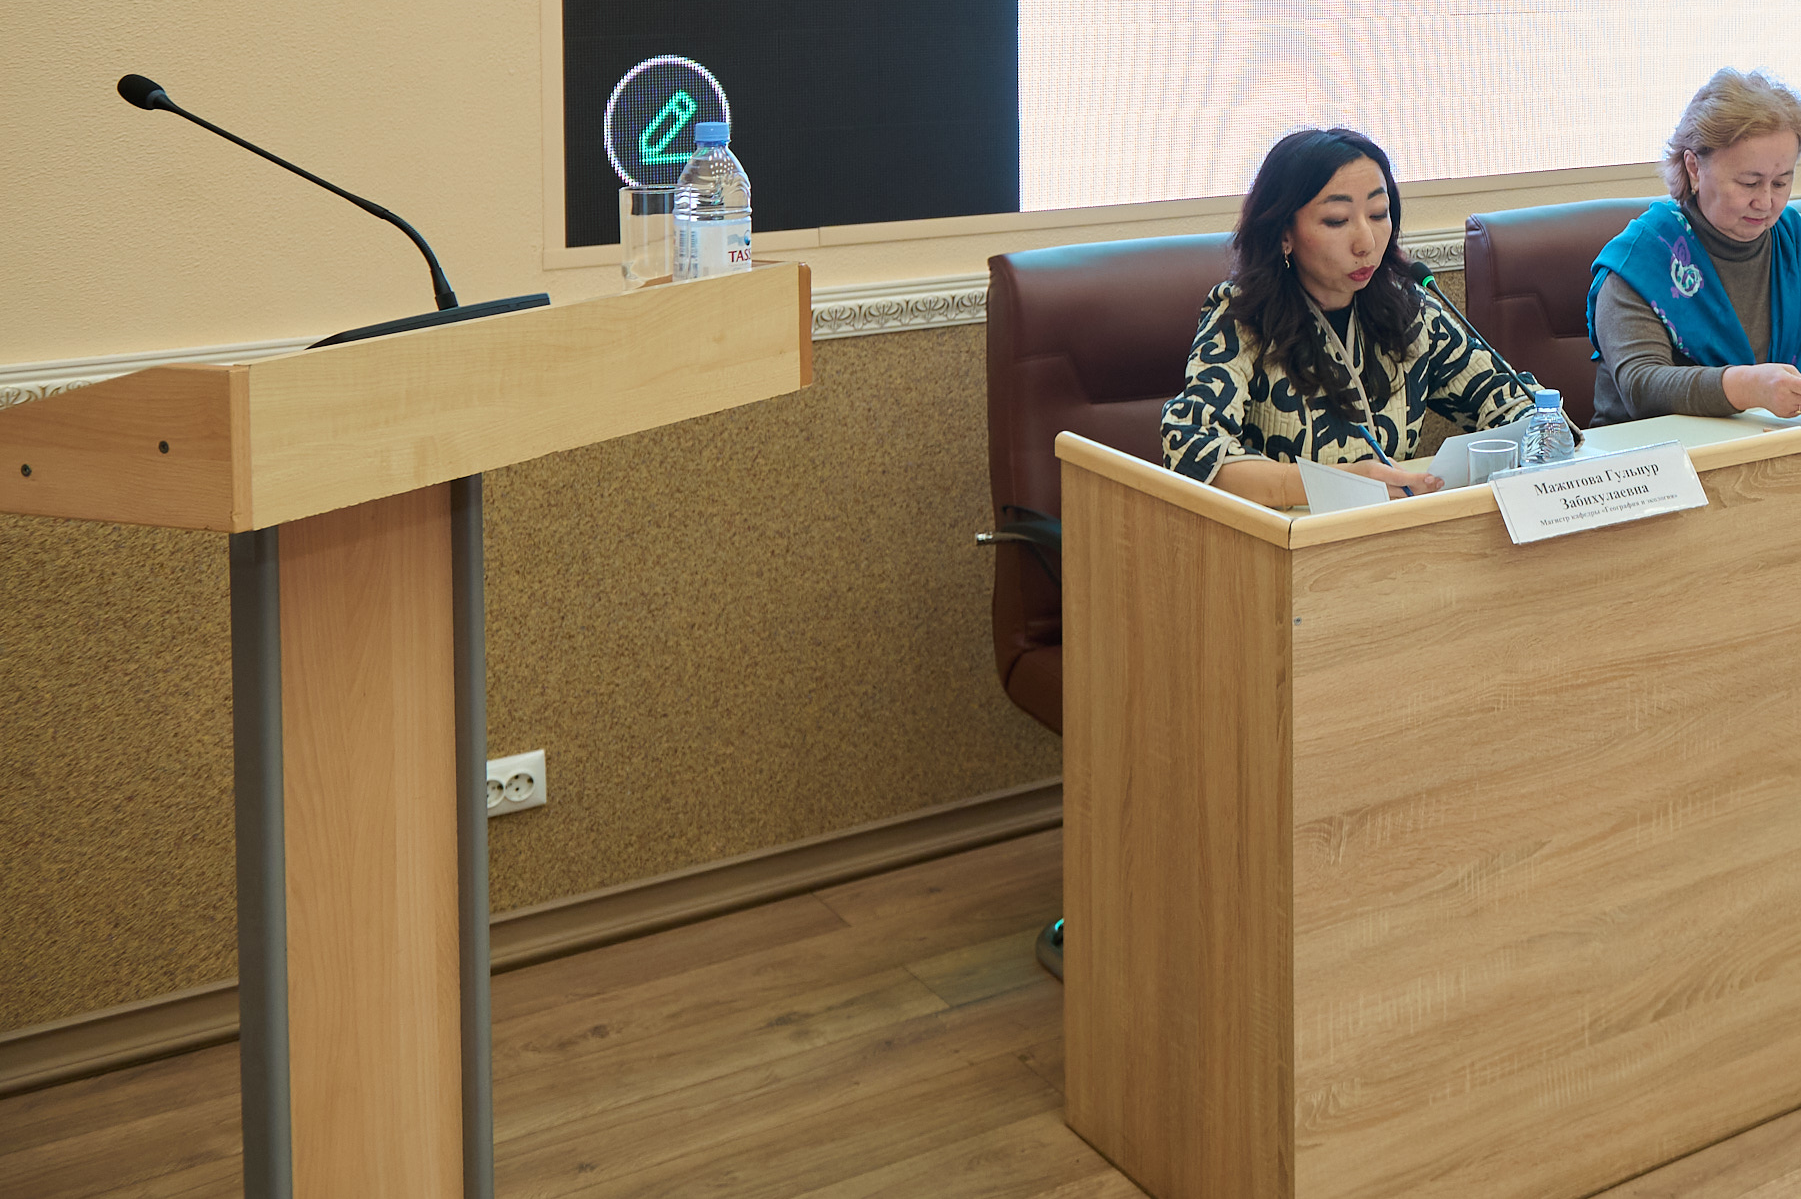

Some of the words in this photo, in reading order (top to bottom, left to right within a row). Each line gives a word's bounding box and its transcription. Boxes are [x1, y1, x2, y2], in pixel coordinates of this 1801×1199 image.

[1533, 474, 1604, 496] Мажитова
[1604, 463, 1660, 483] Гульнур
[1559, 484, 1650, 510] Забихулаевна
